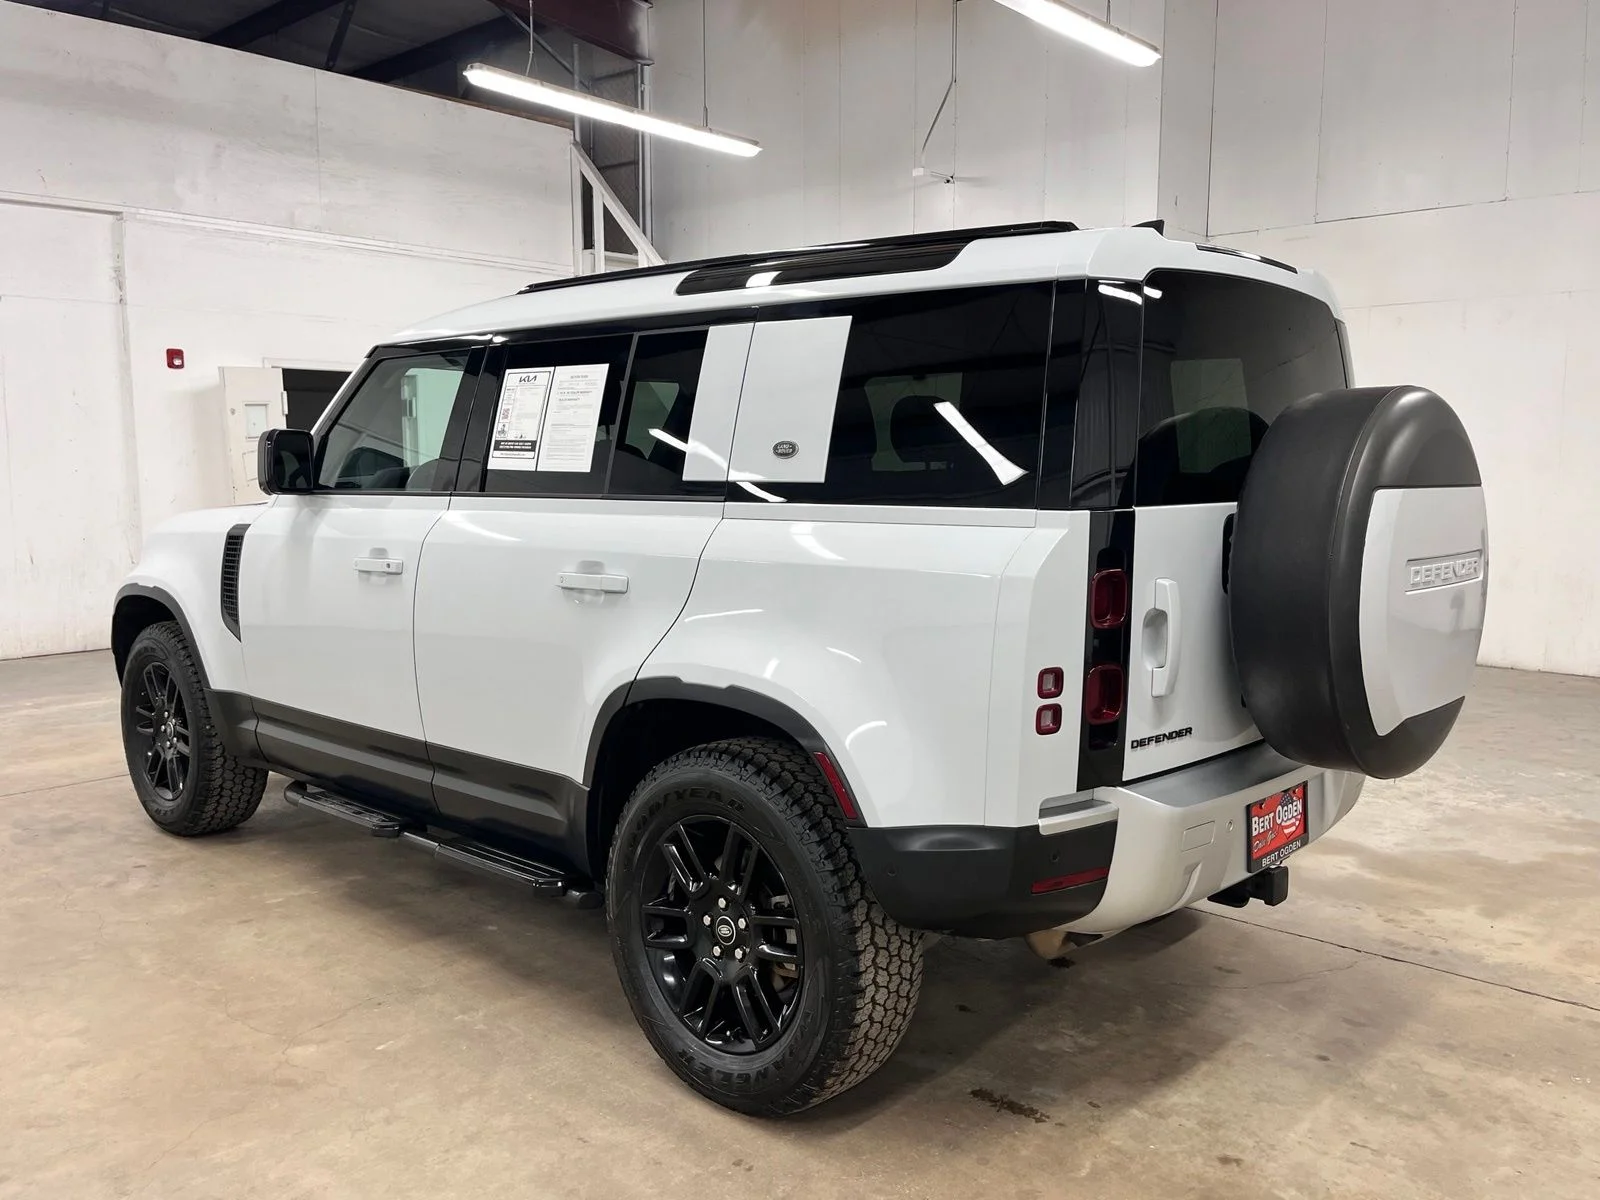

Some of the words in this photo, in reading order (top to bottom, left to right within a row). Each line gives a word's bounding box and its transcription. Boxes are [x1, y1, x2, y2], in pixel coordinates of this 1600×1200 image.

[1410, 557, 1478, 585] DEFENDER
[1130, 727, 1193, 750] DEFENDER
[1252, 813, 1274, 837] BERT
[1276, 799, 1302, 825] OGDEN
[1262, 851, 1278, 867] BERT
[1280, 840, 1301, 857] OGDEN
